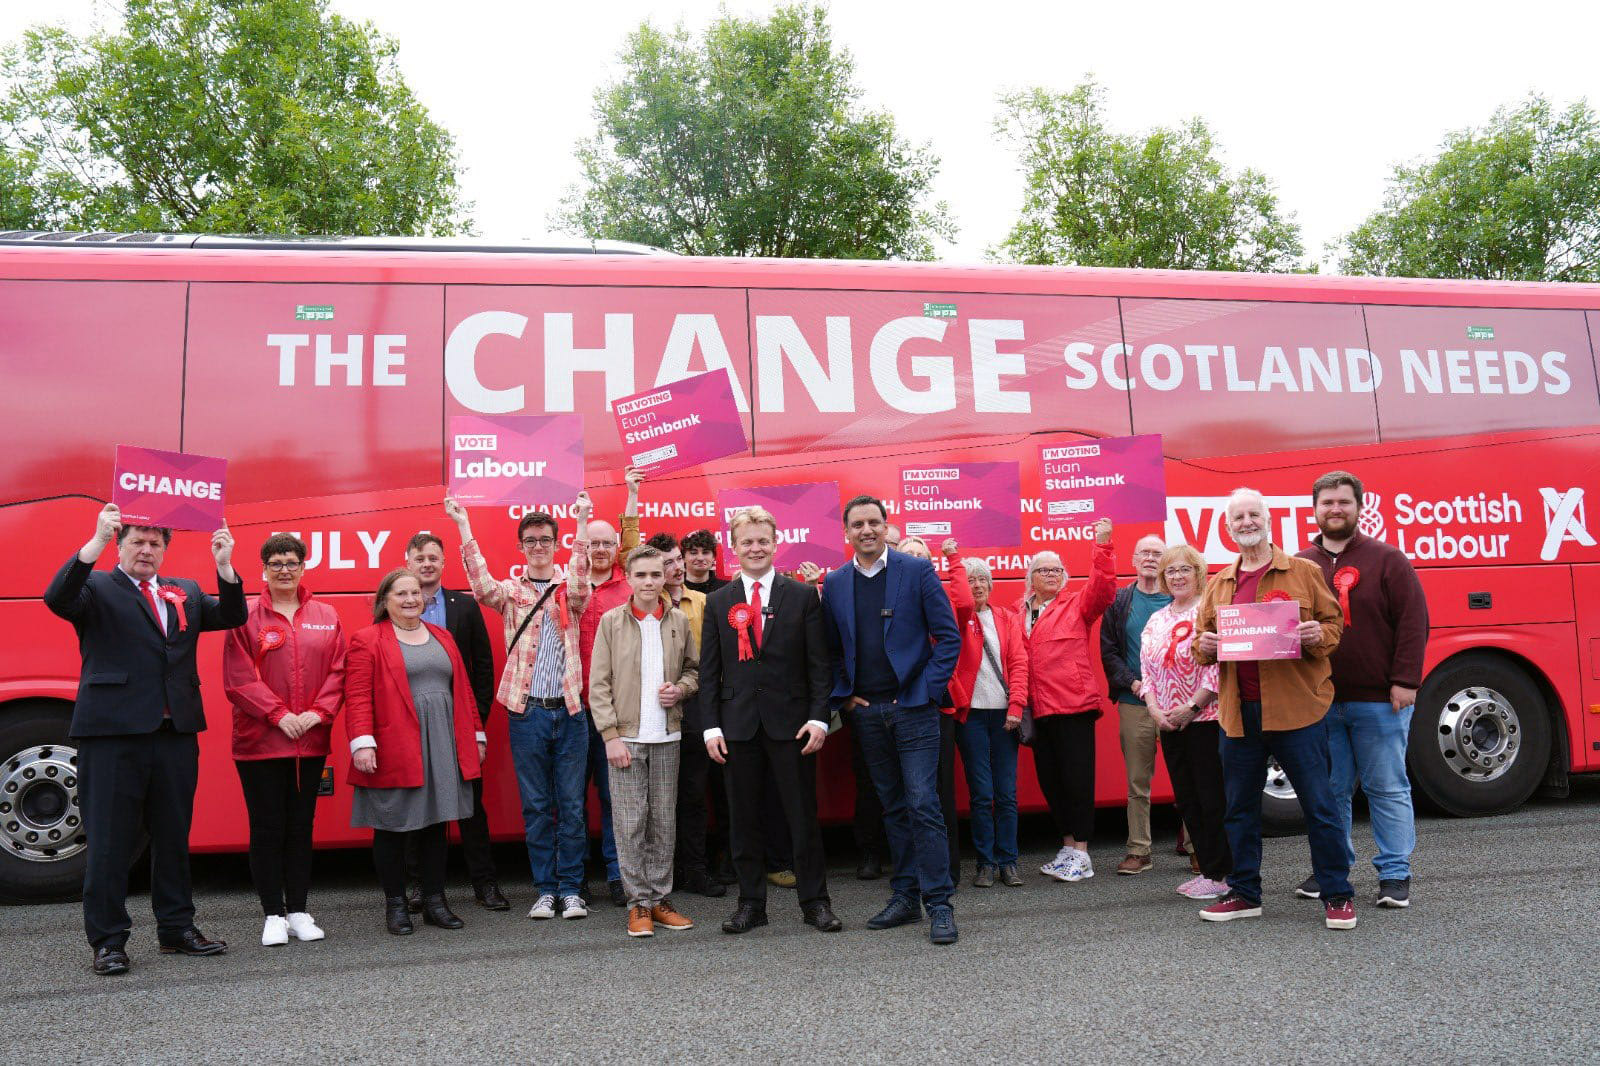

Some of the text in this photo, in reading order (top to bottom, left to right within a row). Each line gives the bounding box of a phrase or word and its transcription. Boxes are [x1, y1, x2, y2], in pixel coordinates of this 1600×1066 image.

[267, 310, 1571, 414] THE CHANGE SCOTLAND NEEDS
[618, 392, 670, 414] I'M VOTING
[621, 412, 657, 429] Euan
[625, 413, 702, 444] Stainbank
[458, 437, 494, 448] VOTE
[1044, 446, 1099, 459] I'M VOTING
[455, 457, 547, 478] Labour
[904, 469, 958, 479] I'M VOTING
[1045, 462, 1081, 475] Euan
[119, 472, 222, 501] CHANGE
[904, 484, 940, 496] Euan
[1045, 473, 1125, 490] Stainbank
[904, 497, 983, 511] Stainbank
[1394, 492, 1522, 525] Scottish
[1030, 525, 1097, 541] CHANG
[1397, 528, 1510, 560] Labour
[1221, 626, 1278, 636] STAINBANK
